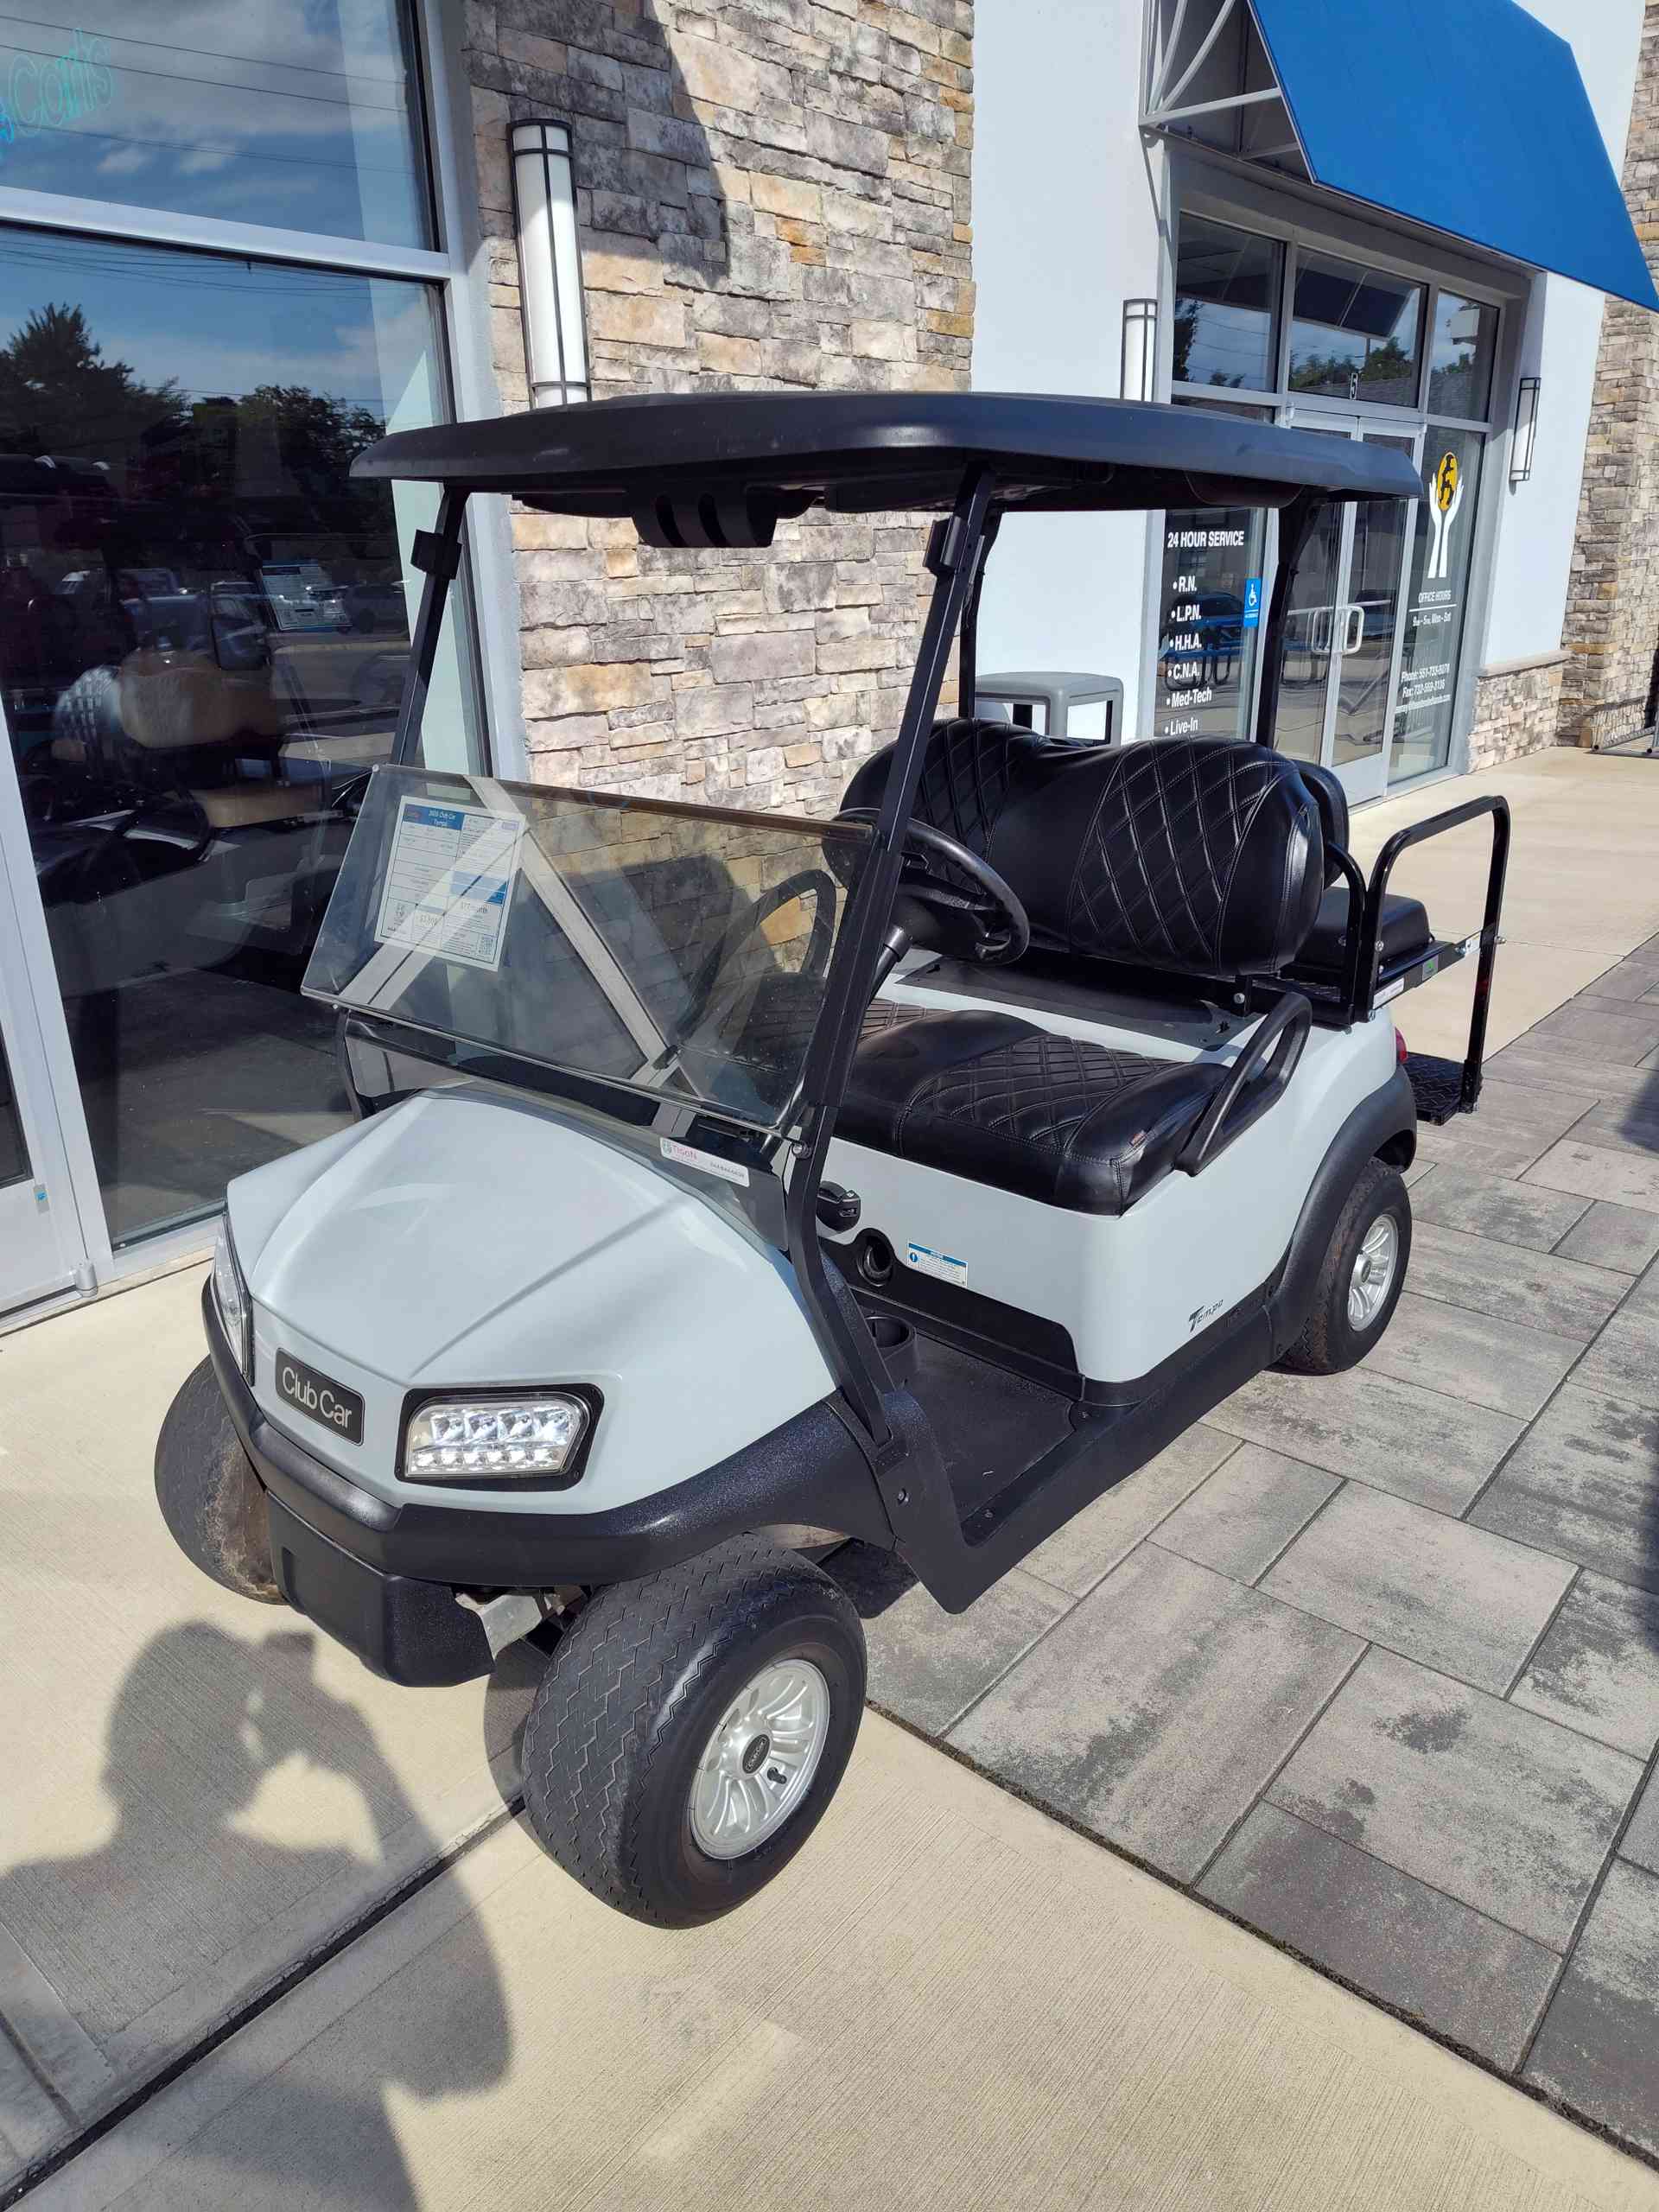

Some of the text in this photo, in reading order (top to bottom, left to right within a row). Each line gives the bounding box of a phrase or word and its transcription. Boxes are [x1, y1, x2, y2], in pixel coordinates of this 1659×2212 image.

[1167, 531, 1244, 548] 24 HOUR SERVICE
[1179, 575, 1198, 593] R.N.
[1176, 604, 1202, 622] L.P.N.
[1175, 633, 1202, 651] H.H.A.
[1173, 662, 1199, 680] C.N.A.
[1172, 687, 1211, 708] Med-Tech
[1170, 717, 1198, 735] Live-In
[283, 1367, 353, 1429] Club Car
